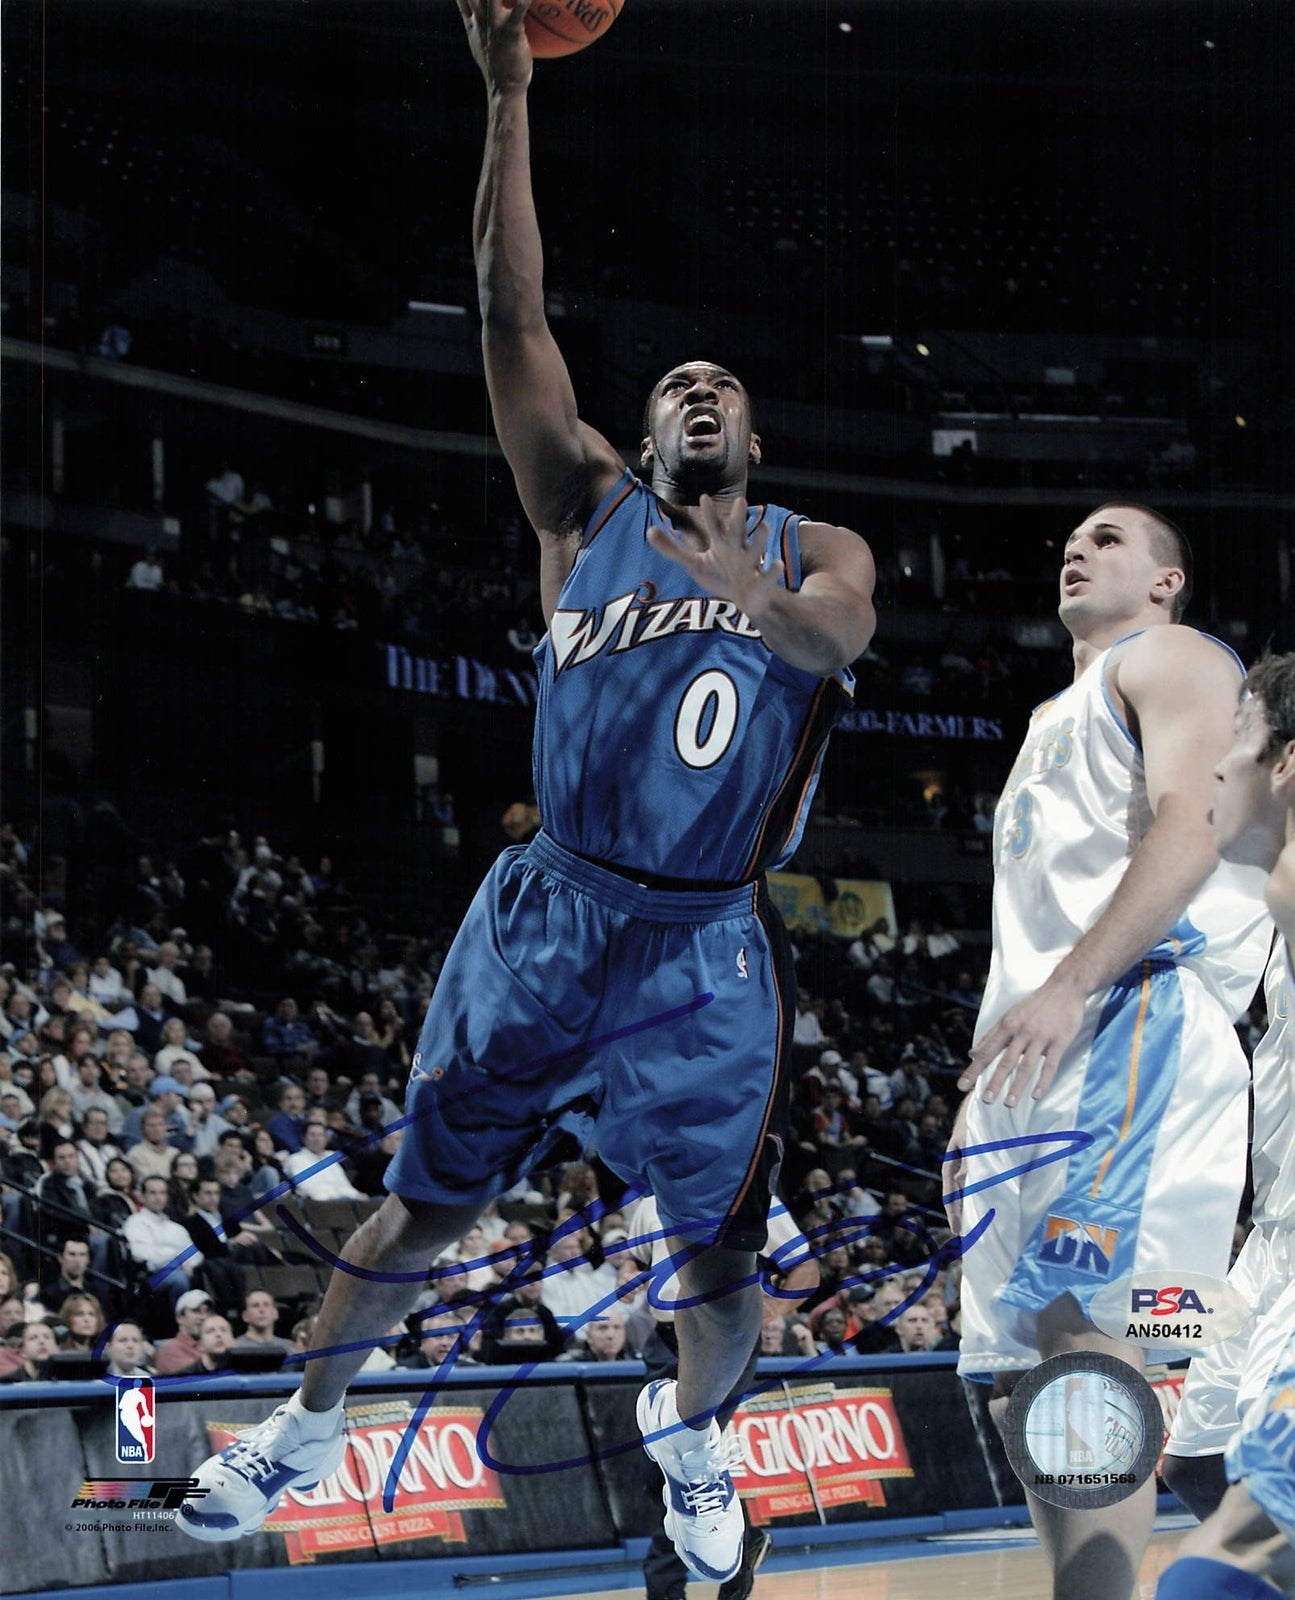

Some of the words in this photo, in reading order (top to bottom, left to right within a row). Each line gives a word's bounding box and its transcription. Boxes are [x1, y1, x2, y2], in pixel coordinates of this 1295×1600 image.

[673, 668, 740, 770] 0
[280, 1422, 485, 1507] ORNO
[735, 1401, 896, 1478] GIORNO
